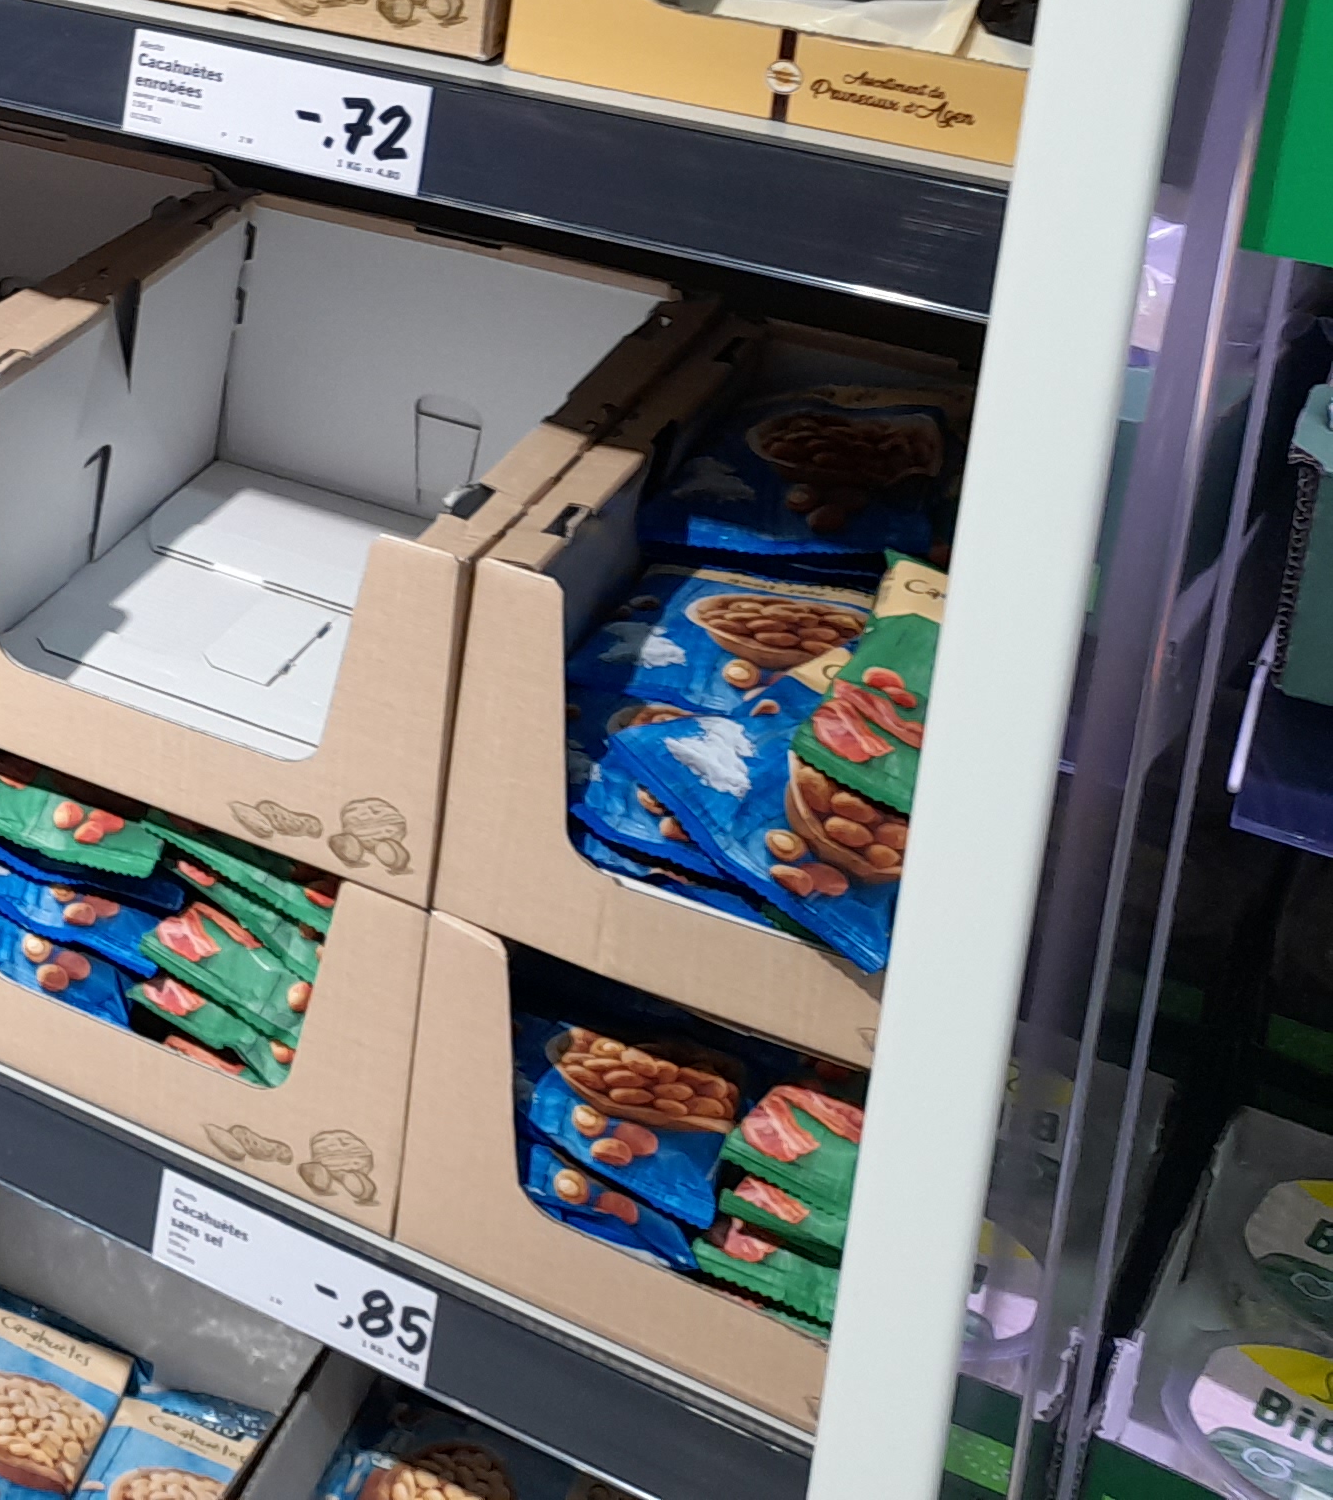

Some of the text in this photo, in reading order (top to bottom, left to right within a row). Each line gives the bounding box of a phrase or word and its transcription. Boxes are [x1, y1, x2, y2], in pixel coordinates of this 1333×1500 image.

[138, 52, 223, 83] Cacahuètes
[135, 74, 202, 99] enrobées
[171, 1217, 224, 1249] sans sel
[172, 1198, 249, 1243] Cacahuètes
